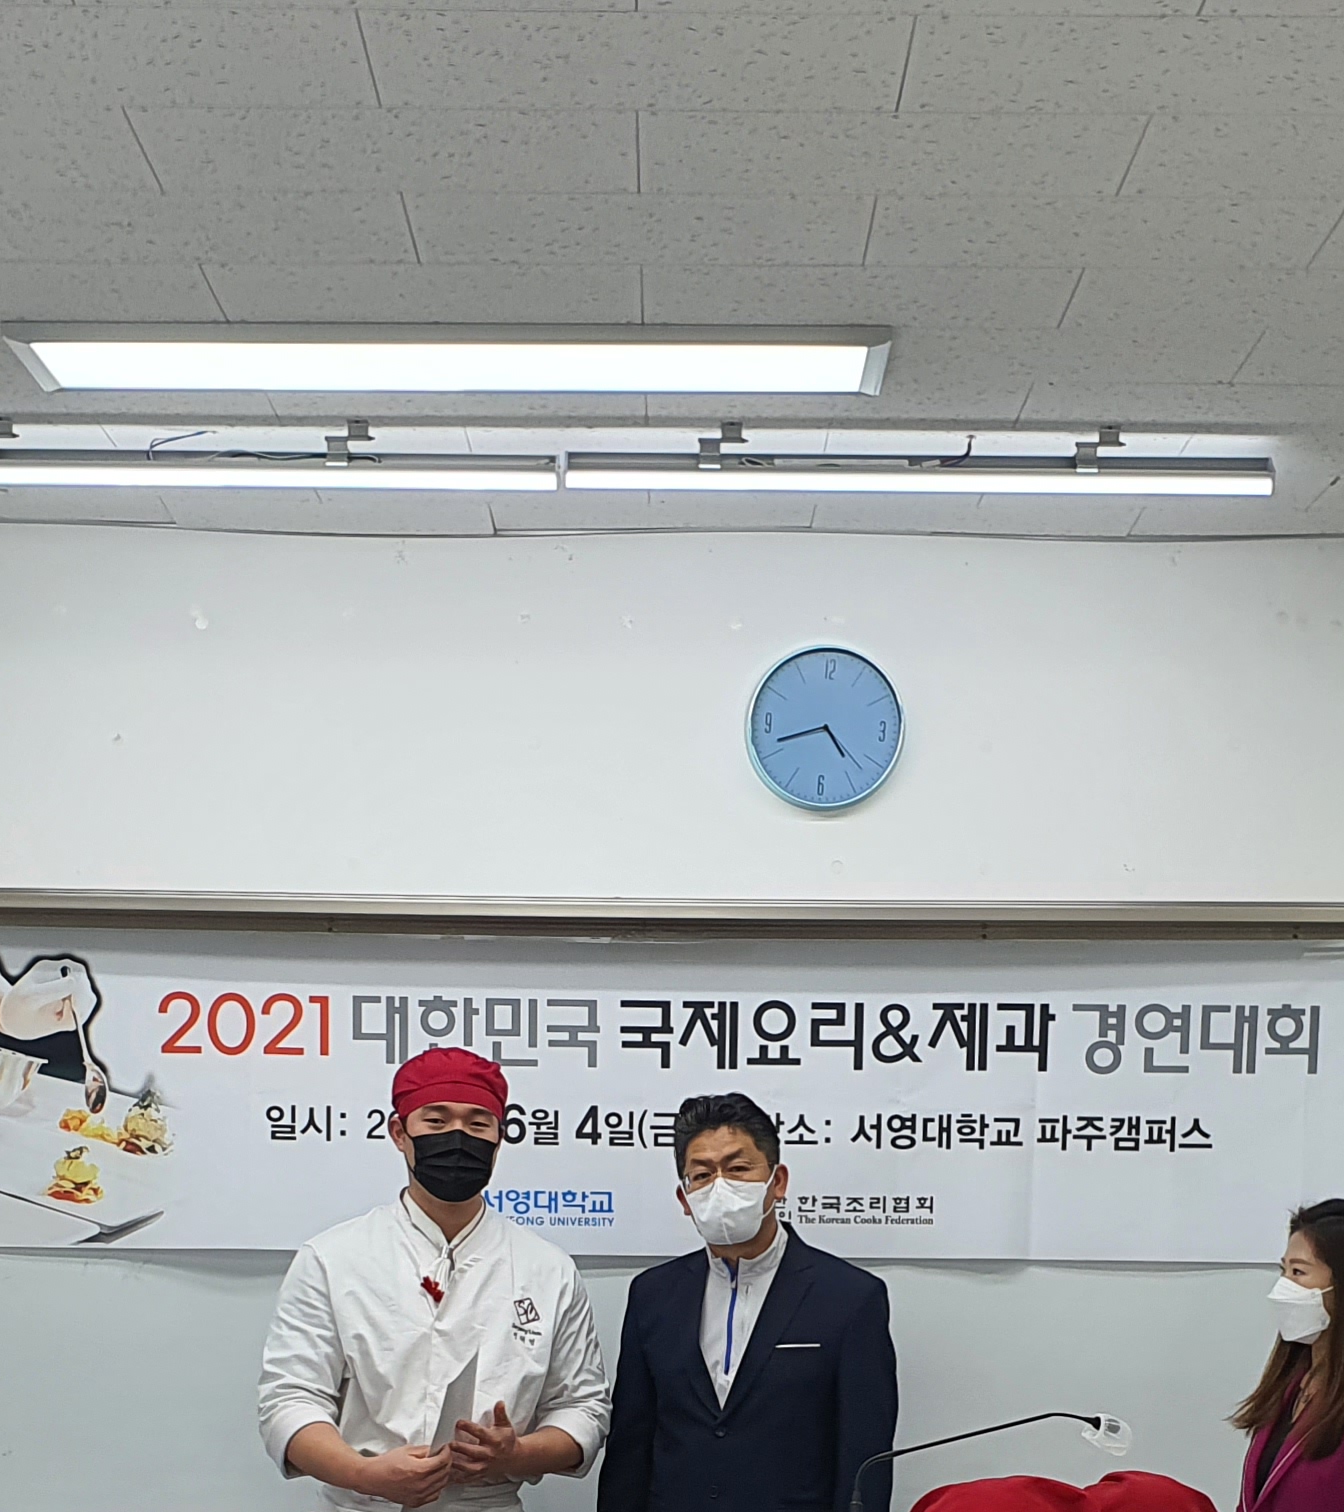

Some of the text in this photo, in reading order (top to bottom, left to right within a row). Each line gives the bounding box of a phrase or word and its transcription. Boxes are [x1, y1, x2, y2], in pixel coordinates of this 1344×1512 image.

[824, 658, 837, 681] 12
[764, 712, 773, 734] 9
[878, 721, 887, 743] 3
[816, 774, 825, 796] 6
[157, 991, 1320, 1075] 2021 대한민국 국제요리&제과 경연대회
[265, 1104, 347, 1142] 일시:
[503, 1104, 559, 1146] 6월
[850, 1113, 1023, 1149] 서영대학교
[1036, 1115, 1213, 1152] 파주캠퍼스
[484, 1190, 614, 1215] 서영대학교
[797, 1195, 934, 1214] 한국조리협회
[549, 1216, 615, 1227] UNIVERSITY
[797, 1214, 816, 1225] The
[818, 1214, 851, 1225] Korean
[884, 1215, 934, 1226] Federation
